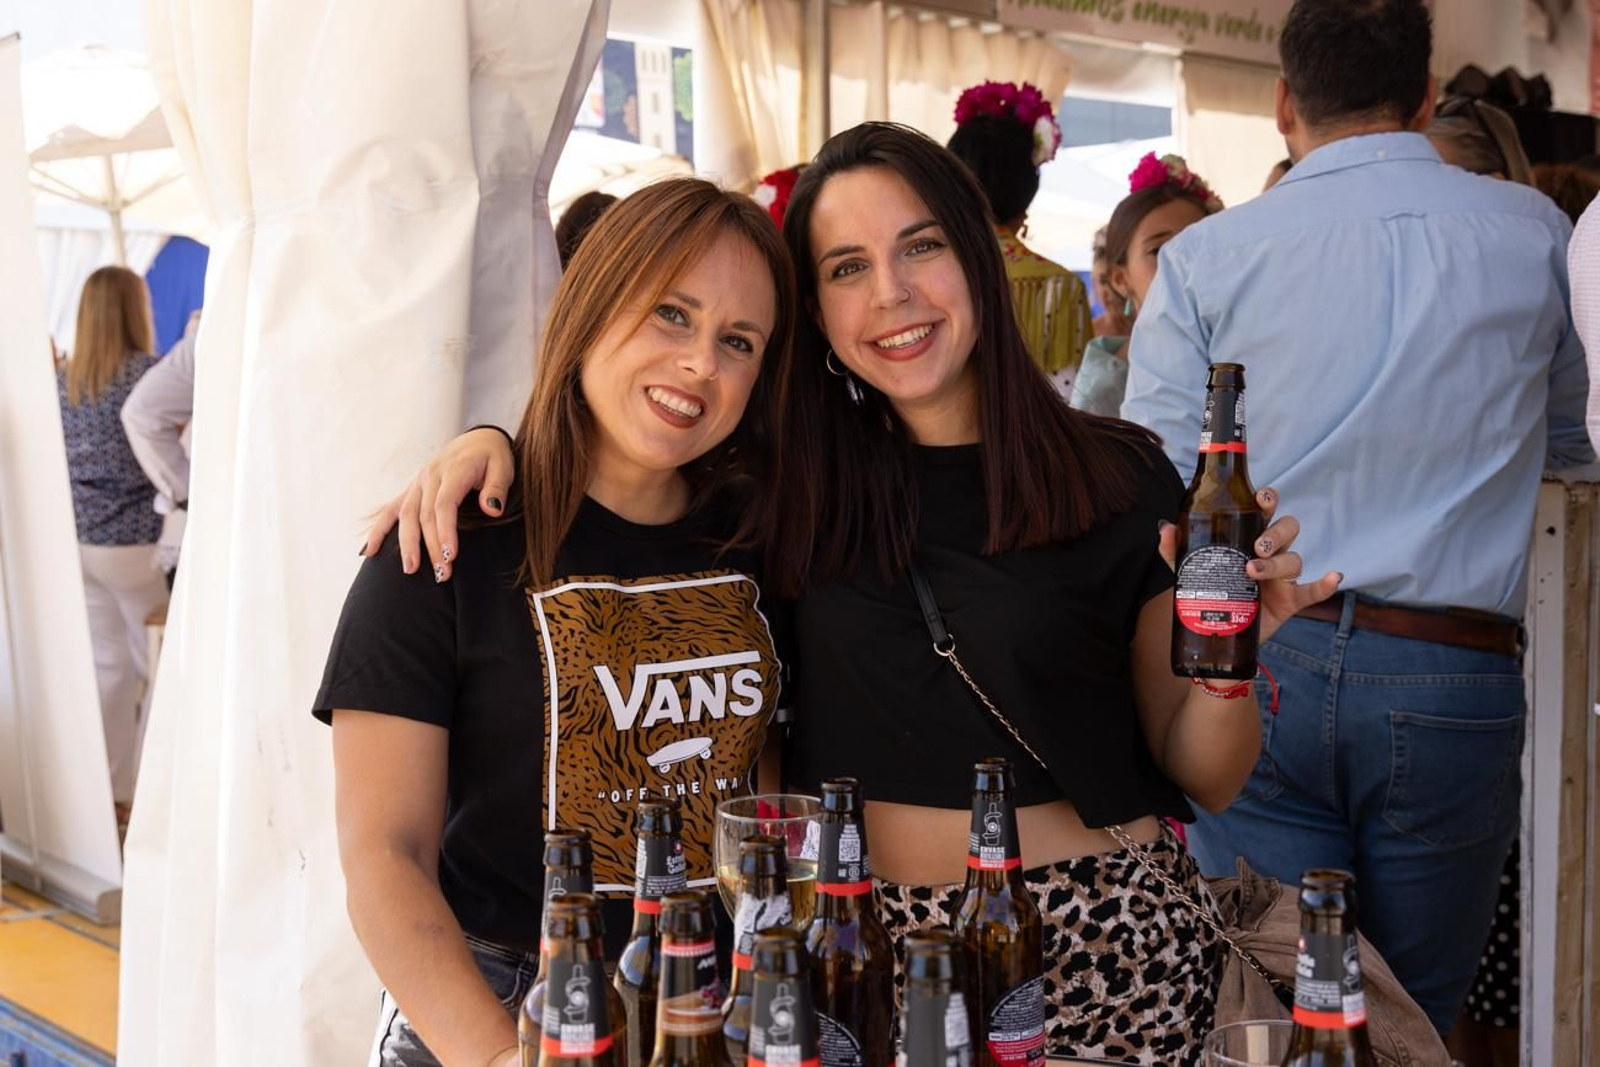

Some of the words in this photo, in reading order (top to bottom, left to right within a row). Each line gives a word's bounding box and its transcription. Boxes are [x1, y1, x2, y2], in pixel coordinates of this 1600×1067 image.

[593, 650, 763, 731] VANS
[662, 781, 700, 797] THE
[715, 777, 743, 792] WA
